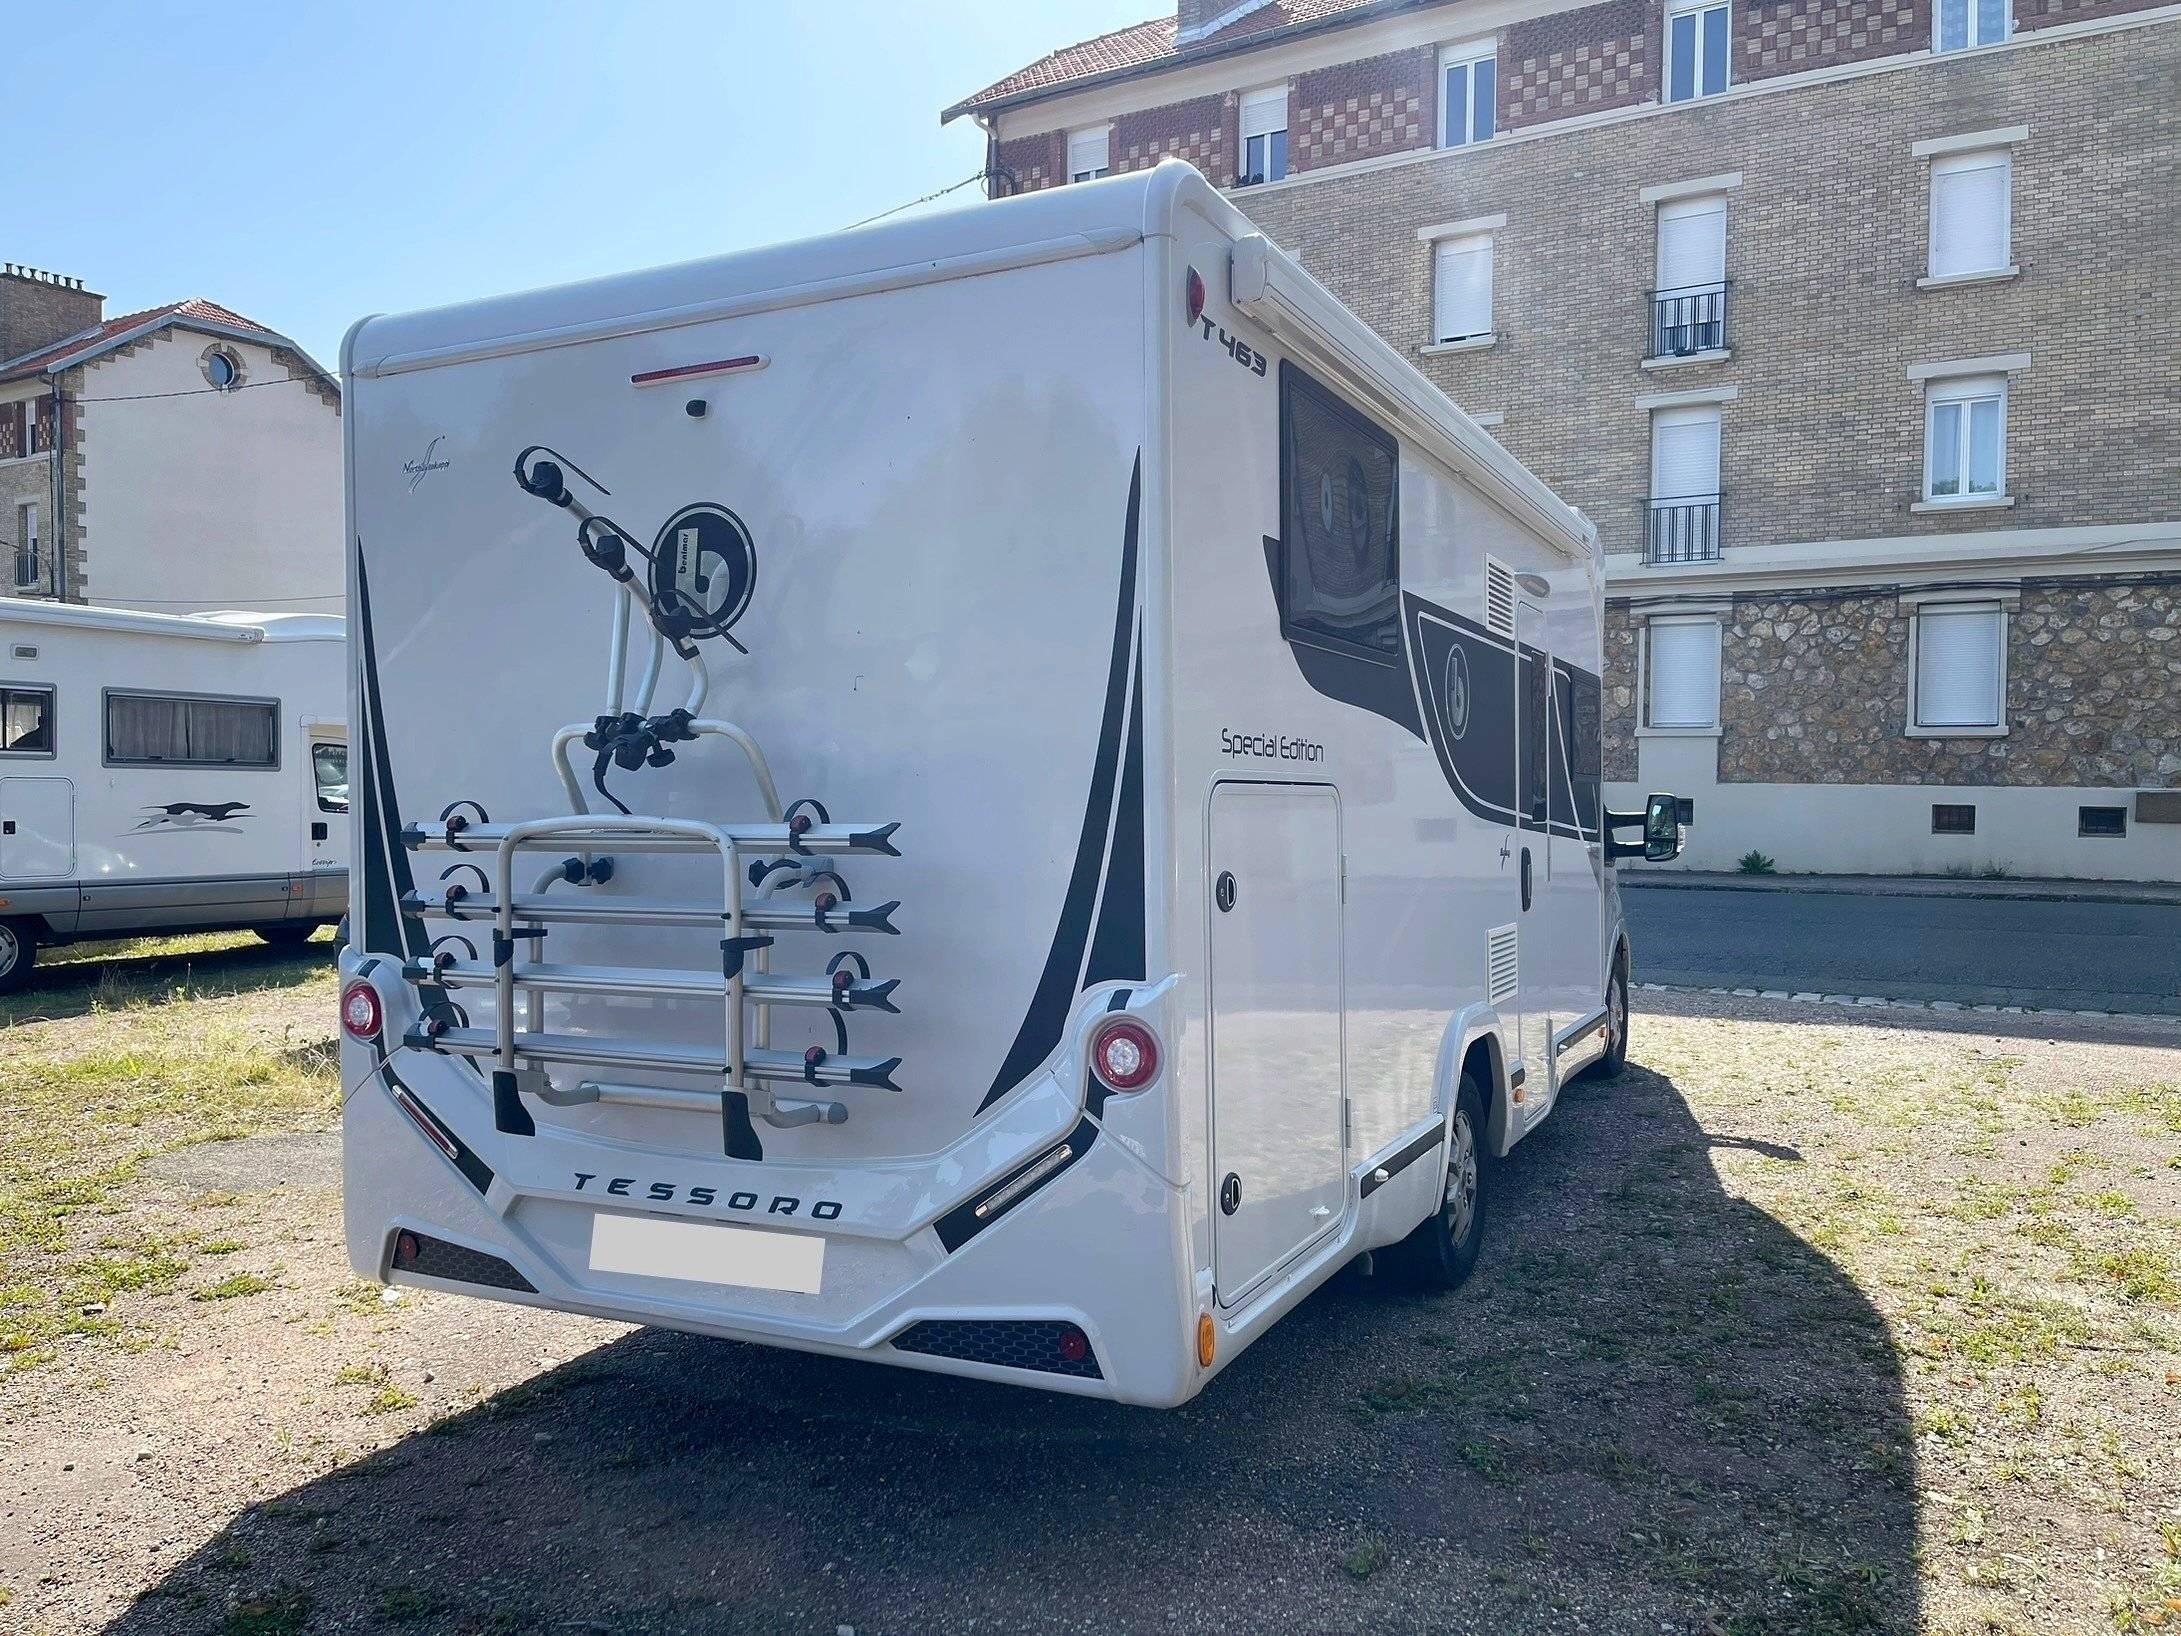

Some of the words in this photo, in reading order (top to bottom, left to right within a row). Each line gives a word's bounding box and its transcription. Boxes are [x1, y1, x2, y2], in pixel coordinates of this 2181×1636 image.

[1200, 314, 1216, 341] T
[1219, 328, 1267, 377] 463
[1222, 728, 1277, 759] Special
[1280, 736, 1324, 762] Edition
[574, 1172, 843, 1220] TESSORO
